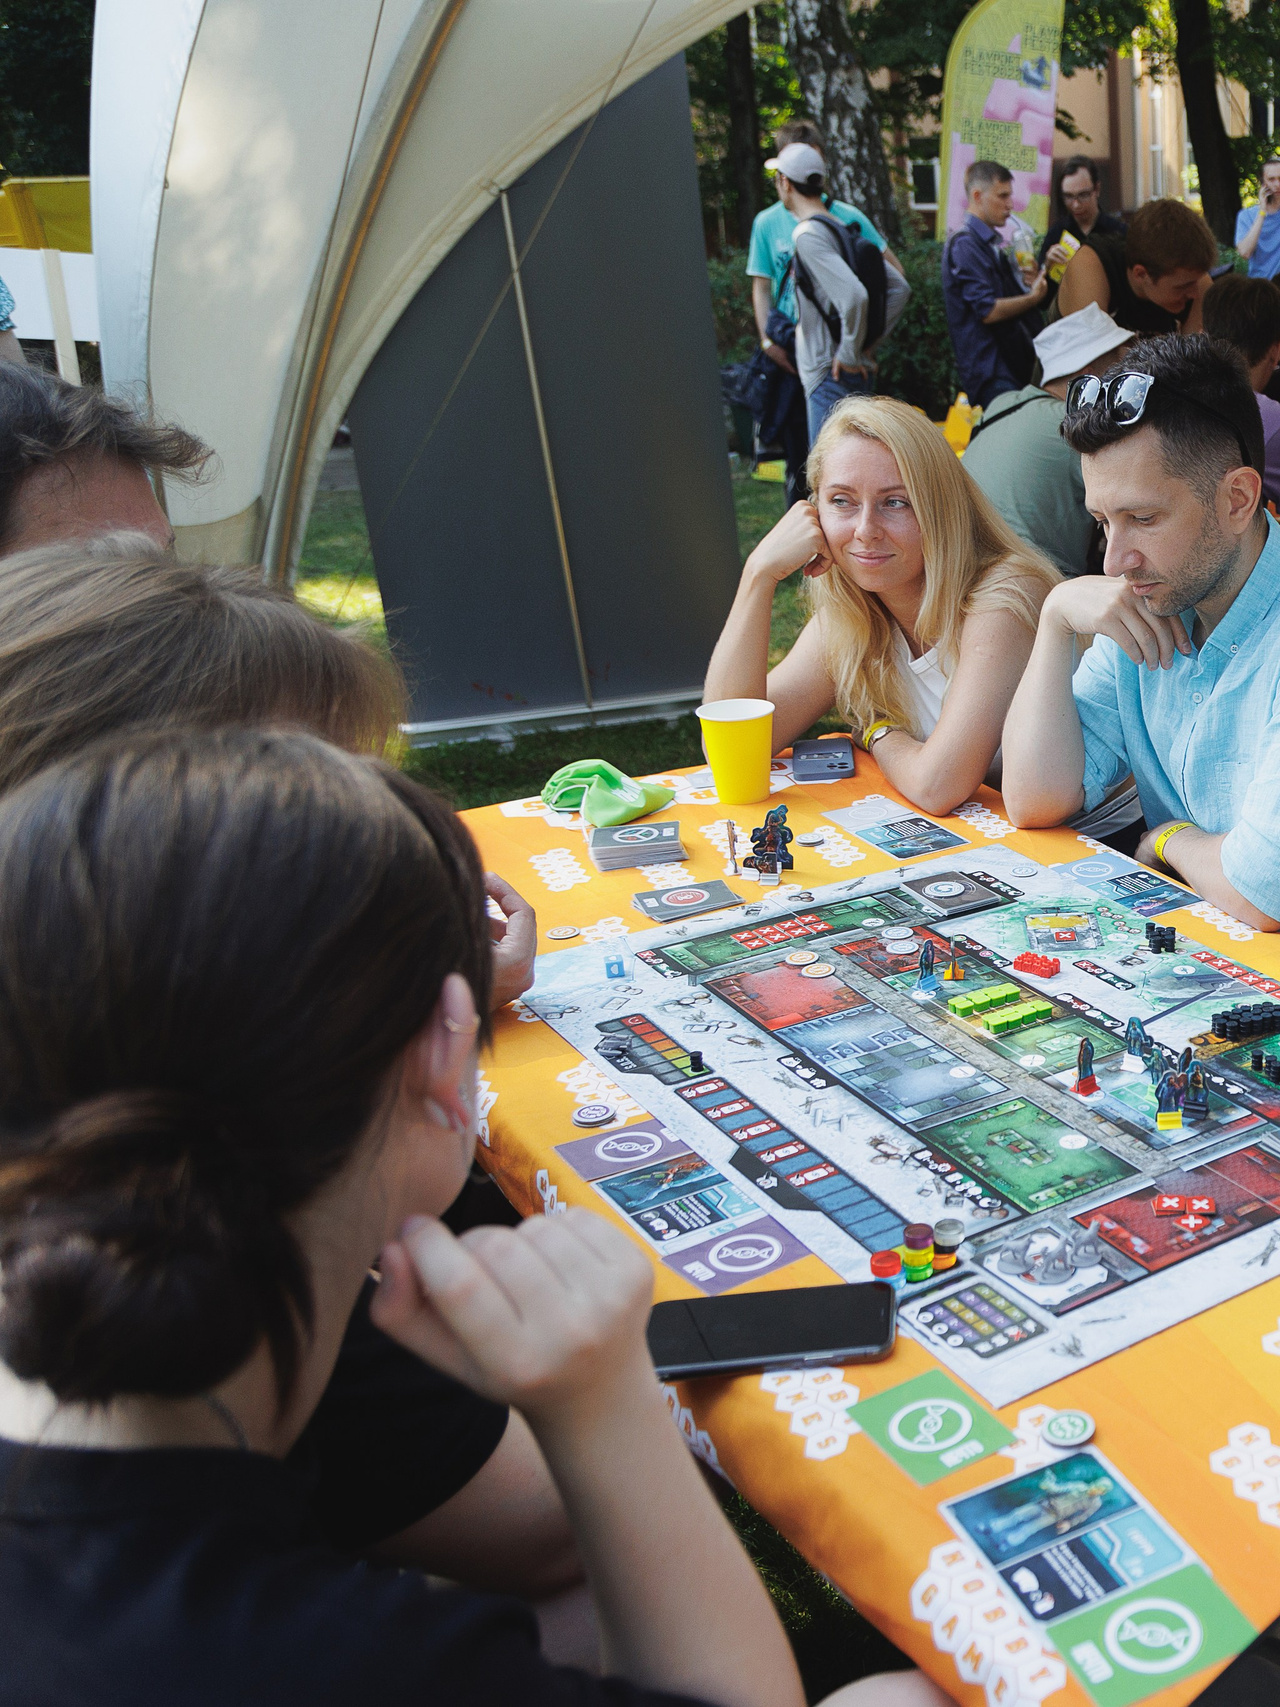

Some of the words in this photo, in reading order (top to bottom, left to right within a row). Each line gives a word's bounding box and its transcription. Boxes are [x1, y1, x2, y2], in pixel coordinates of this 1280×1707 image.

[1024, 25, 1061, 39] PLAYP
[770, 1375, 838, 1450] AMES
[942, 1550, 1051, 1684] HOBBY
